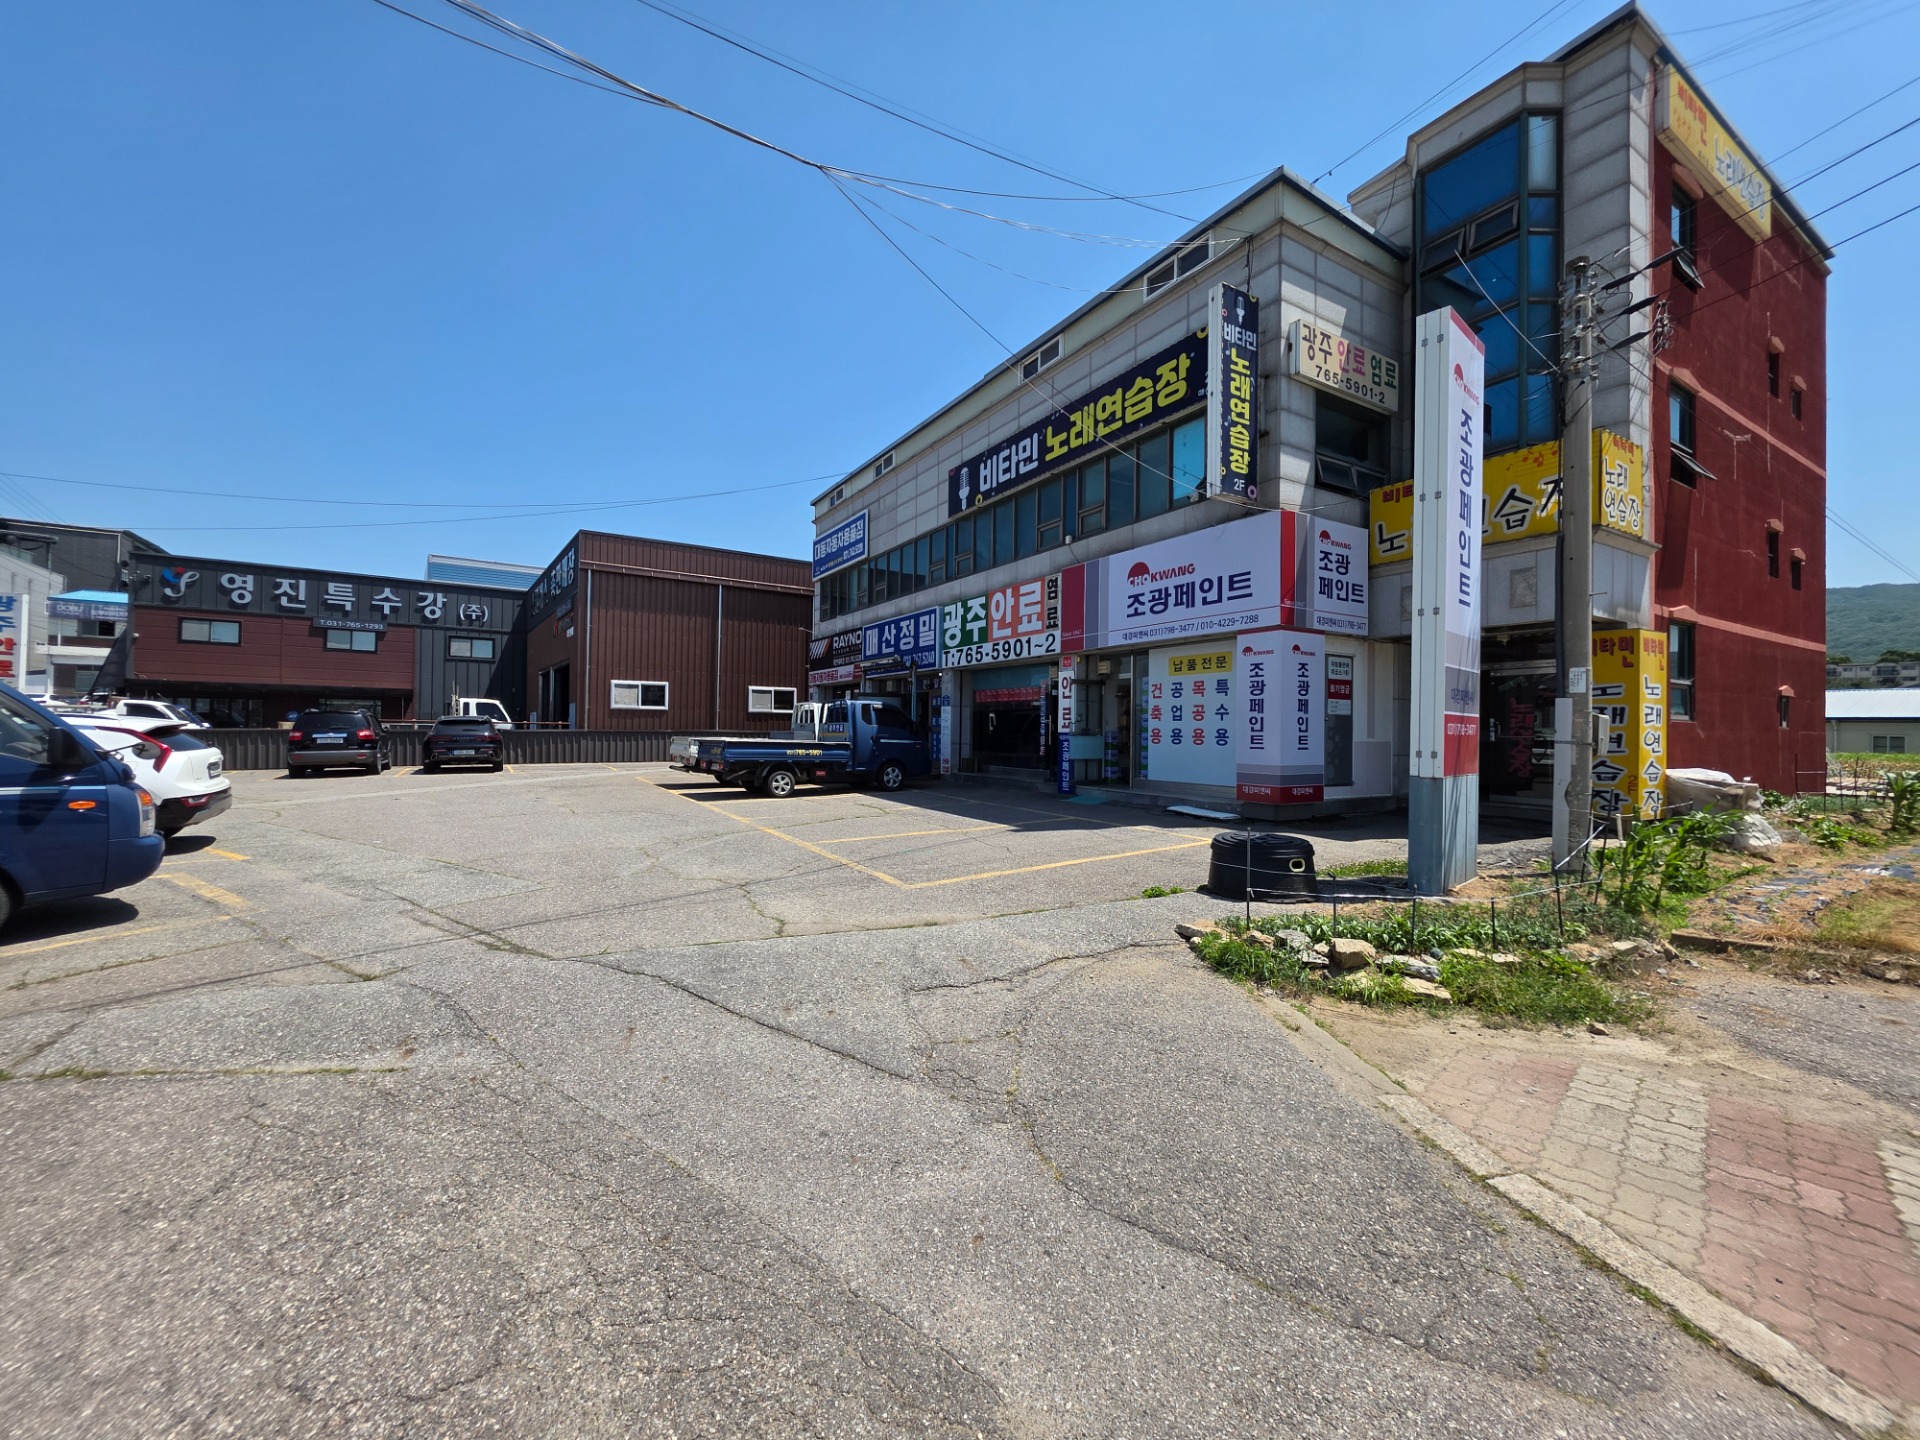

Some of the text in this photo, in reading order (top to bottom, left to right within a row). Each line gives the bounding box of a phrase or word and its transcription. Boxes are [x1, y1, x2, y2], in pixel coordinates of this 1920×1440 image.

[1223, 321, 1257, 352] 비타민
[1301, 323, 1397, 391] 광주 안료 염료
[979, 352, 1191, 493] 비타민 노래연습장
[1229, 347, 1252, 475] 노래연습장
[1233, 478, 1246, 492] 2F
[1604, 457, 1628, 490] 노래
[1458, 408, 1474, 609] 조광페인트
[1604, 488, 1640, 528] 연습장
[1128, 563, 1196, 588] CHOKWANG
[1319, 549, 1351, 576] 조광
[220, 572, 489, 622] 영진특수강 (주)
[1046, 577, 1060, 629] 염료
[1126, 571, 1254, 619] 조광페인트
[1318, 576, 1365, 604] 페인트
[833, 630, 862, 650] RAYNO
[865, 613, 936, 657] 매산정밀
[1149, 623, 1195, 638] 031)798-3477
[1200, 614, 1260, 631] 010-4229-7288
[1173, 656, 1228, 673] 납품전문
[1643, 636, 1665, 671] 비타민
[1150, 683, 1163, 745] 건축용
[1170, 682, 1184, 745] 공업용
[1192, 681, 1206, 746] 목공용
[1215, 679, 1230, 747] 특수용
[1248, 662, 1266, 750] 조광페인트
[1297, 662, 1310, 750] 조광페인트
[1643, 676, 1664, 813] 노래연습장
